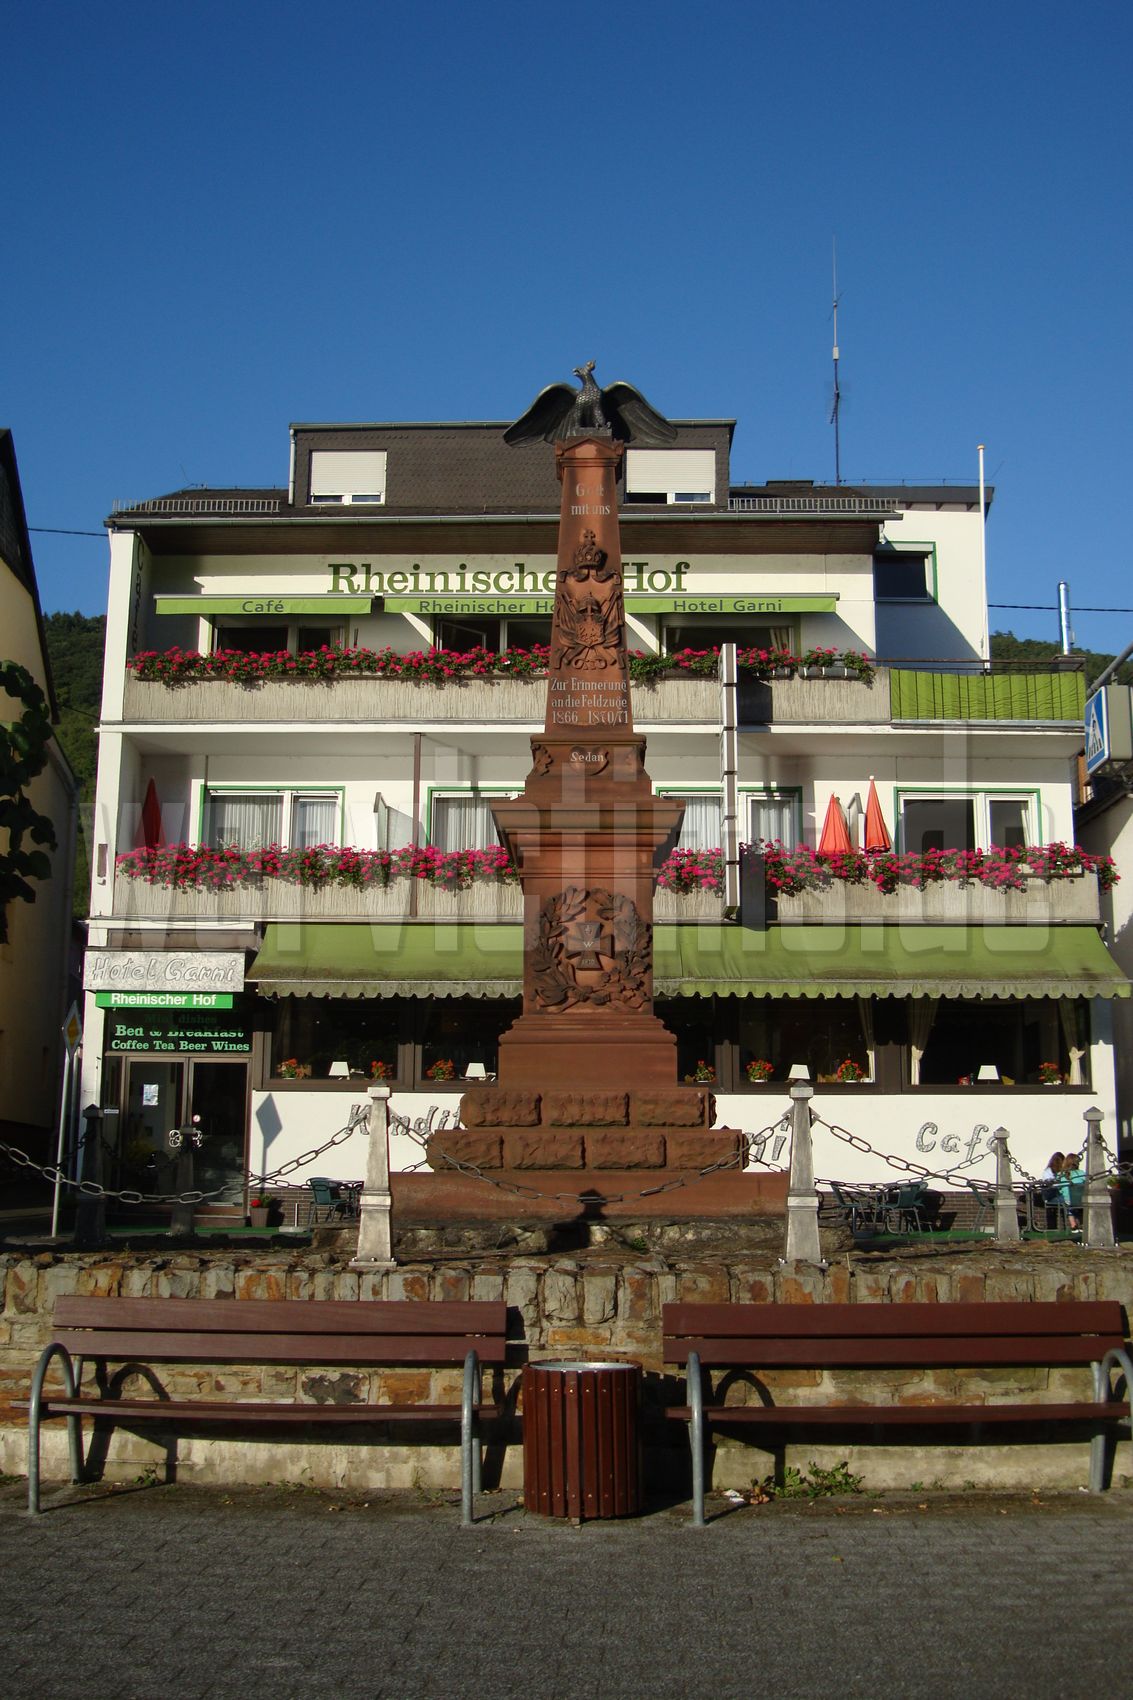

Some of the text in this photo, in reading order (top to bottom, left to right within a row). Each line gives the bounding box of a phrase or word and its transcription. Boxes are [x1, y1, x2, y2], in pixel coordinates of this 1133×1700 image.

[327, 562, 690, 593] Rheinische Hof
[242, 600, 284, 613] Café
[419, 601, 557, 613] Rheinischer Ho
[674, 600, 782, 612] Hotel Garni
[551, 678, 627, 692] Zur Erinnerung
[552, 710, 578, 724] 1866
[570, 751, 604, 762] Sedan
[92, 957, 237, 982] Hotel Garni
[111, 993, 217, 1006] Rheinischer Hof
[115, 1025, 144, 1037] Bed
[111, 1040, 250, 1051] Coffee Tea Beer Wines
